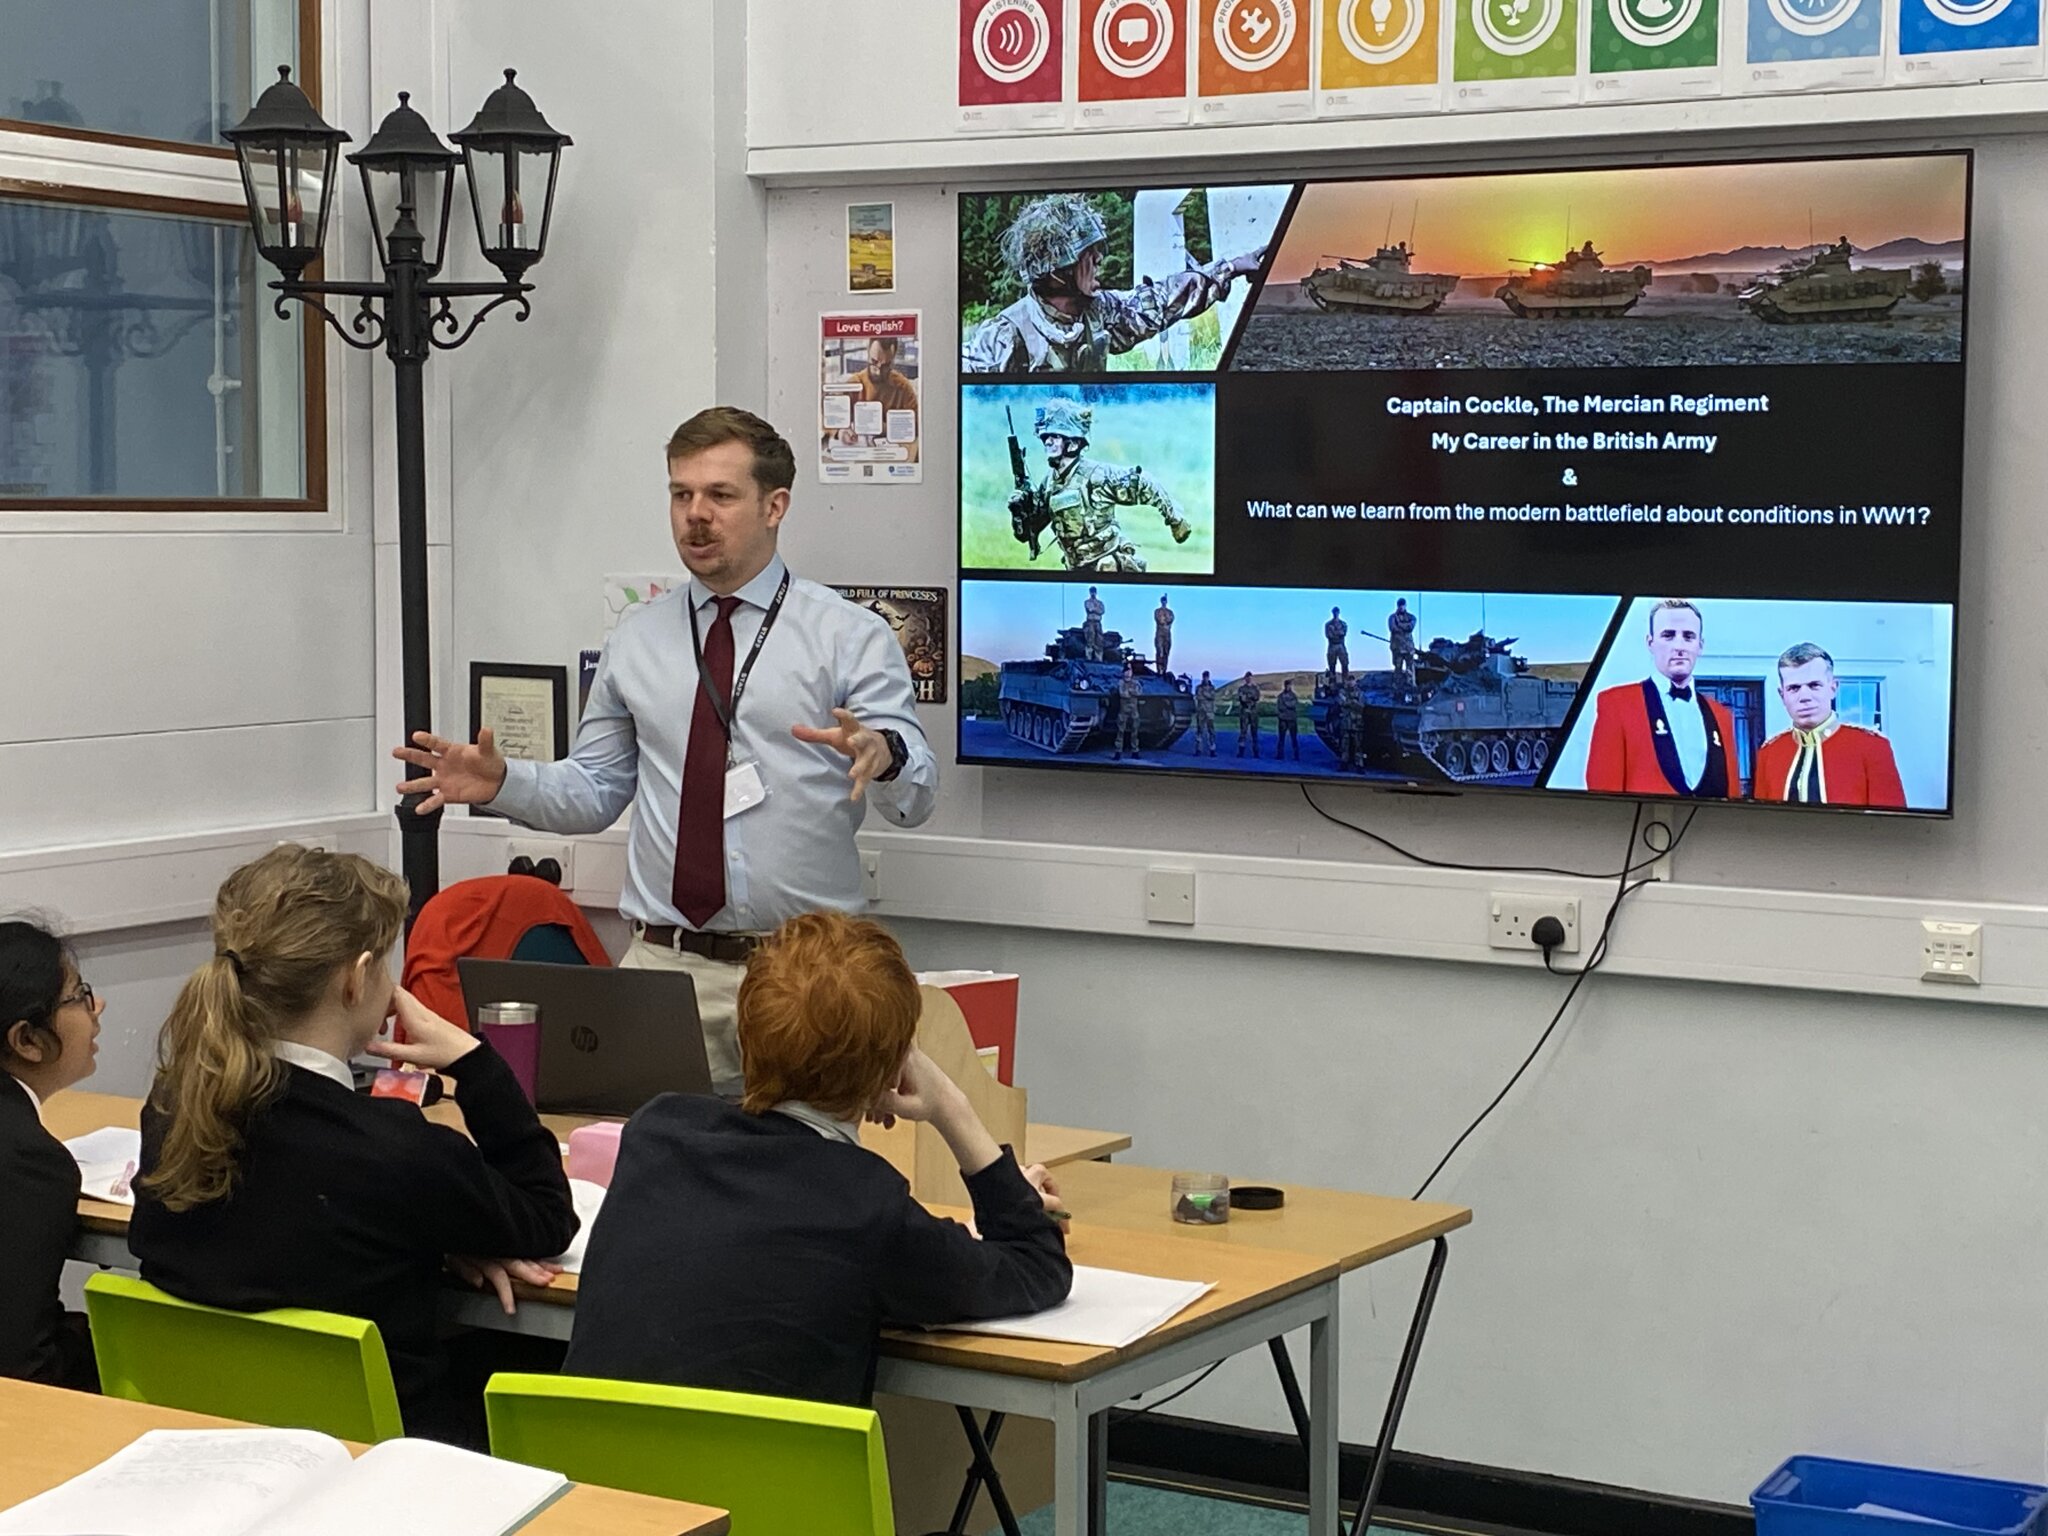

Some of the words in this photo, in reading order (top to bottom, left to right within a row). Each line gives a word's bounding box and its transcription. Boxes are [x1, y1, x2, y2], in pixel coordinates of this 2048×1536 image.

[836, 321, 861, 333] Love
[863, 320, 904, 335] English?
[1386, 396, 1461, 418] Captain
[1464, 396, 1540, 417] Cockle,
[1542, 395, 1580, 413] The
[1583, 394, 1665, 413] Mercian
[1669, 393, 1770, 417] Regiment
[1431, 433, 1459, 454] My
[1463, 433, 1530, 450] Career
[1533, 432, 1552, 450] in
[1555, 432, 1589, 450] the
[1592, 431, 1659, 450] British
[1662, 432, 1718, 454] Army
[1561, 468, 1578, 486] &
[1246, 500, 1293, 518] What
[1296, 504, 1328, 519] can
[1330, 504, 1357, 519] we
[1360, 501, 1406, 520] learn
[1408, 502, 1452, 521] from
[1454, 502, 1485, 521] the
[1489, 503, 1561, 522] modern
[1565, 503, 1662, 523] battlefield
[1665, 504, 1724, 523] about
[1727, 504, 1834, 525] conditions
[1839, 504, 1857, 525] in
[1861, 506, 1931, 526] WW1?
[856, 588, 877, 599] FULL
[877, 589, 890, 599] OF
[755, 626, 769, 649] STAFF
[735, 672, 748, 697] STAFF
